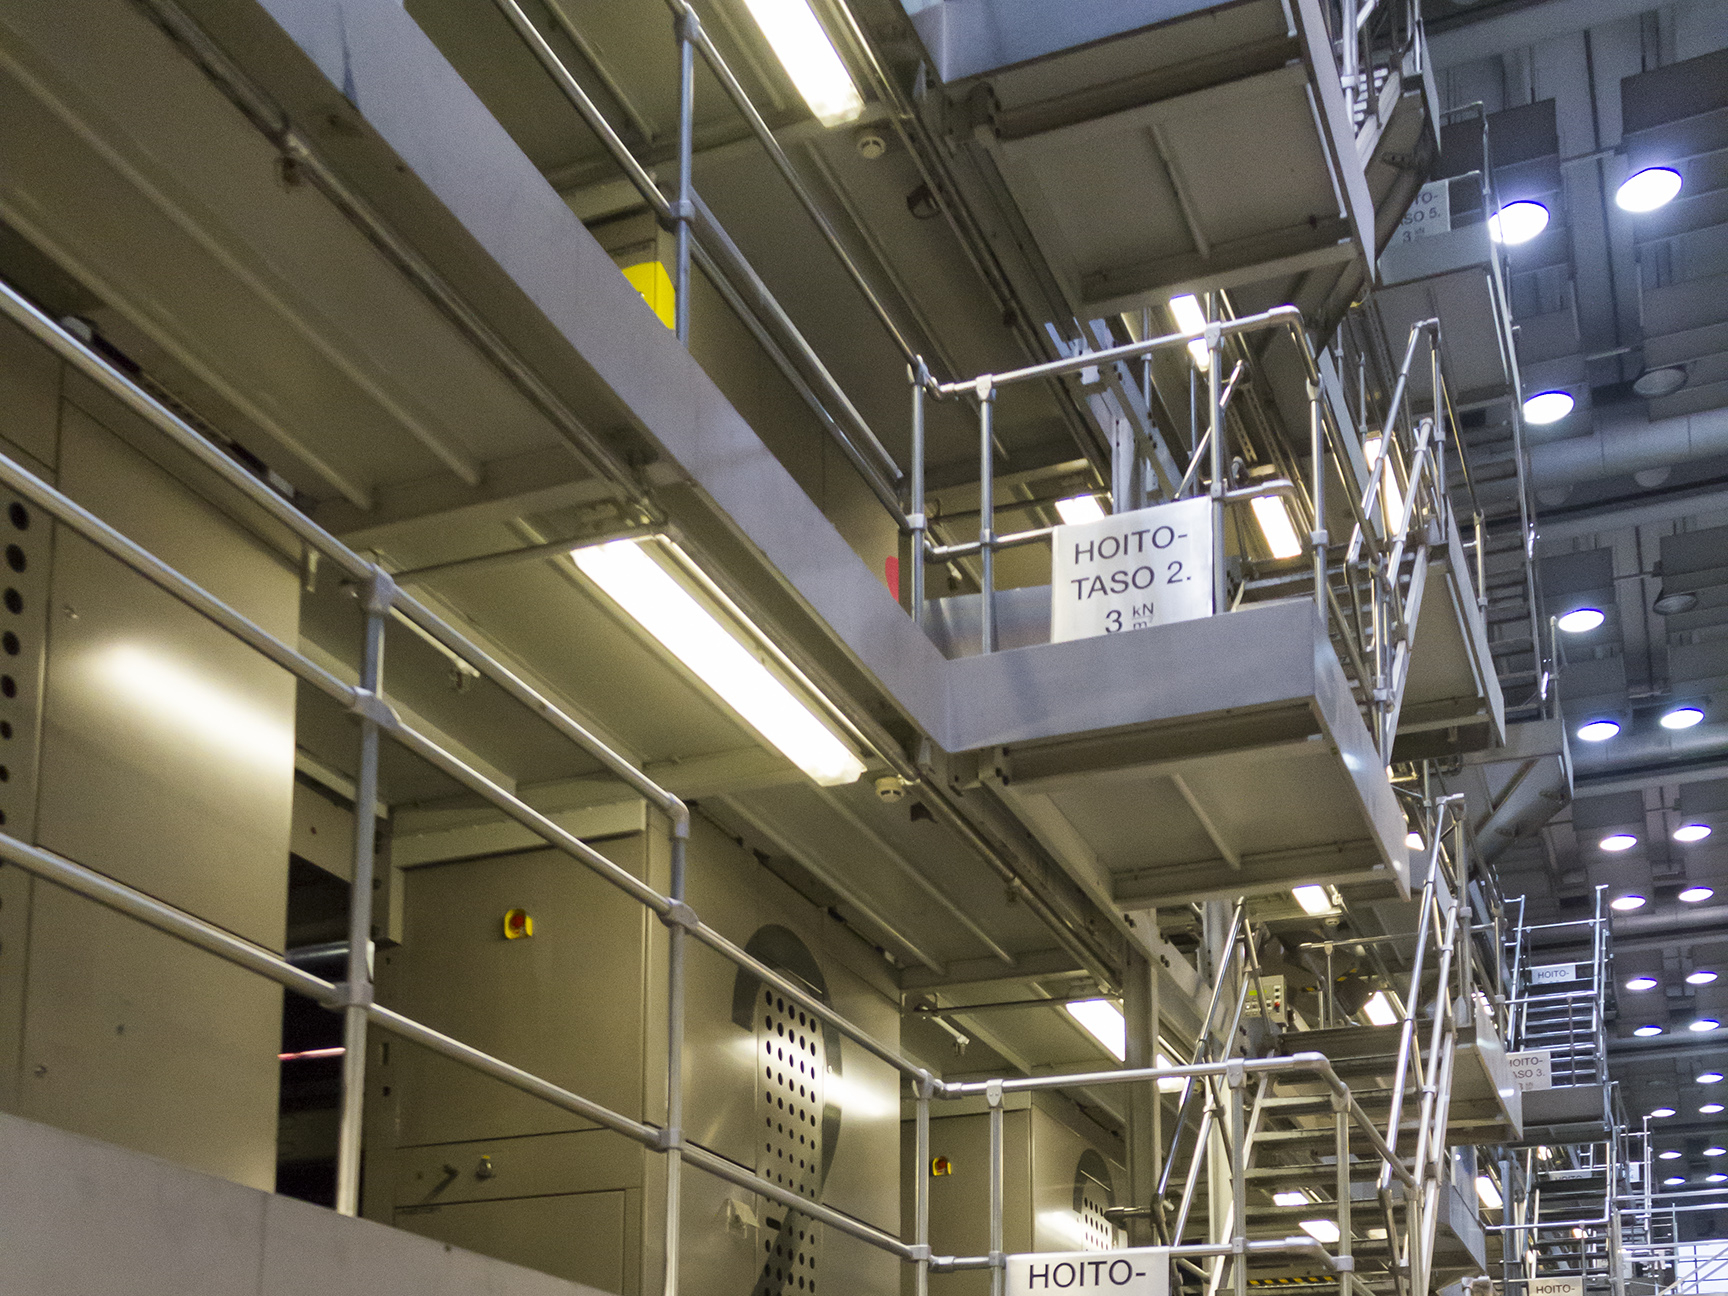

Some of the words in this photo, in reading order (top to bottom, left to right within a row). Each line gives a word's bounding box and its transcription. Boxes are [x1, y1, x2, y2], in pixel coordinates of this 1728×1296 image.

[1075, 525, 1188, 565] HOITO-
[1070, 566, 1155, 601] TASO
[1166, 560, 1192, 585] 2.
[1105, 609, 1123, 634] 3
[1132, 602, 1154, 618] kN
[1537, 969, 1570, 979] HOITO-
[1029, 1259, 1146, 1289] HOITO-
[1535, 1284, 1576, 1295] HOITO-
